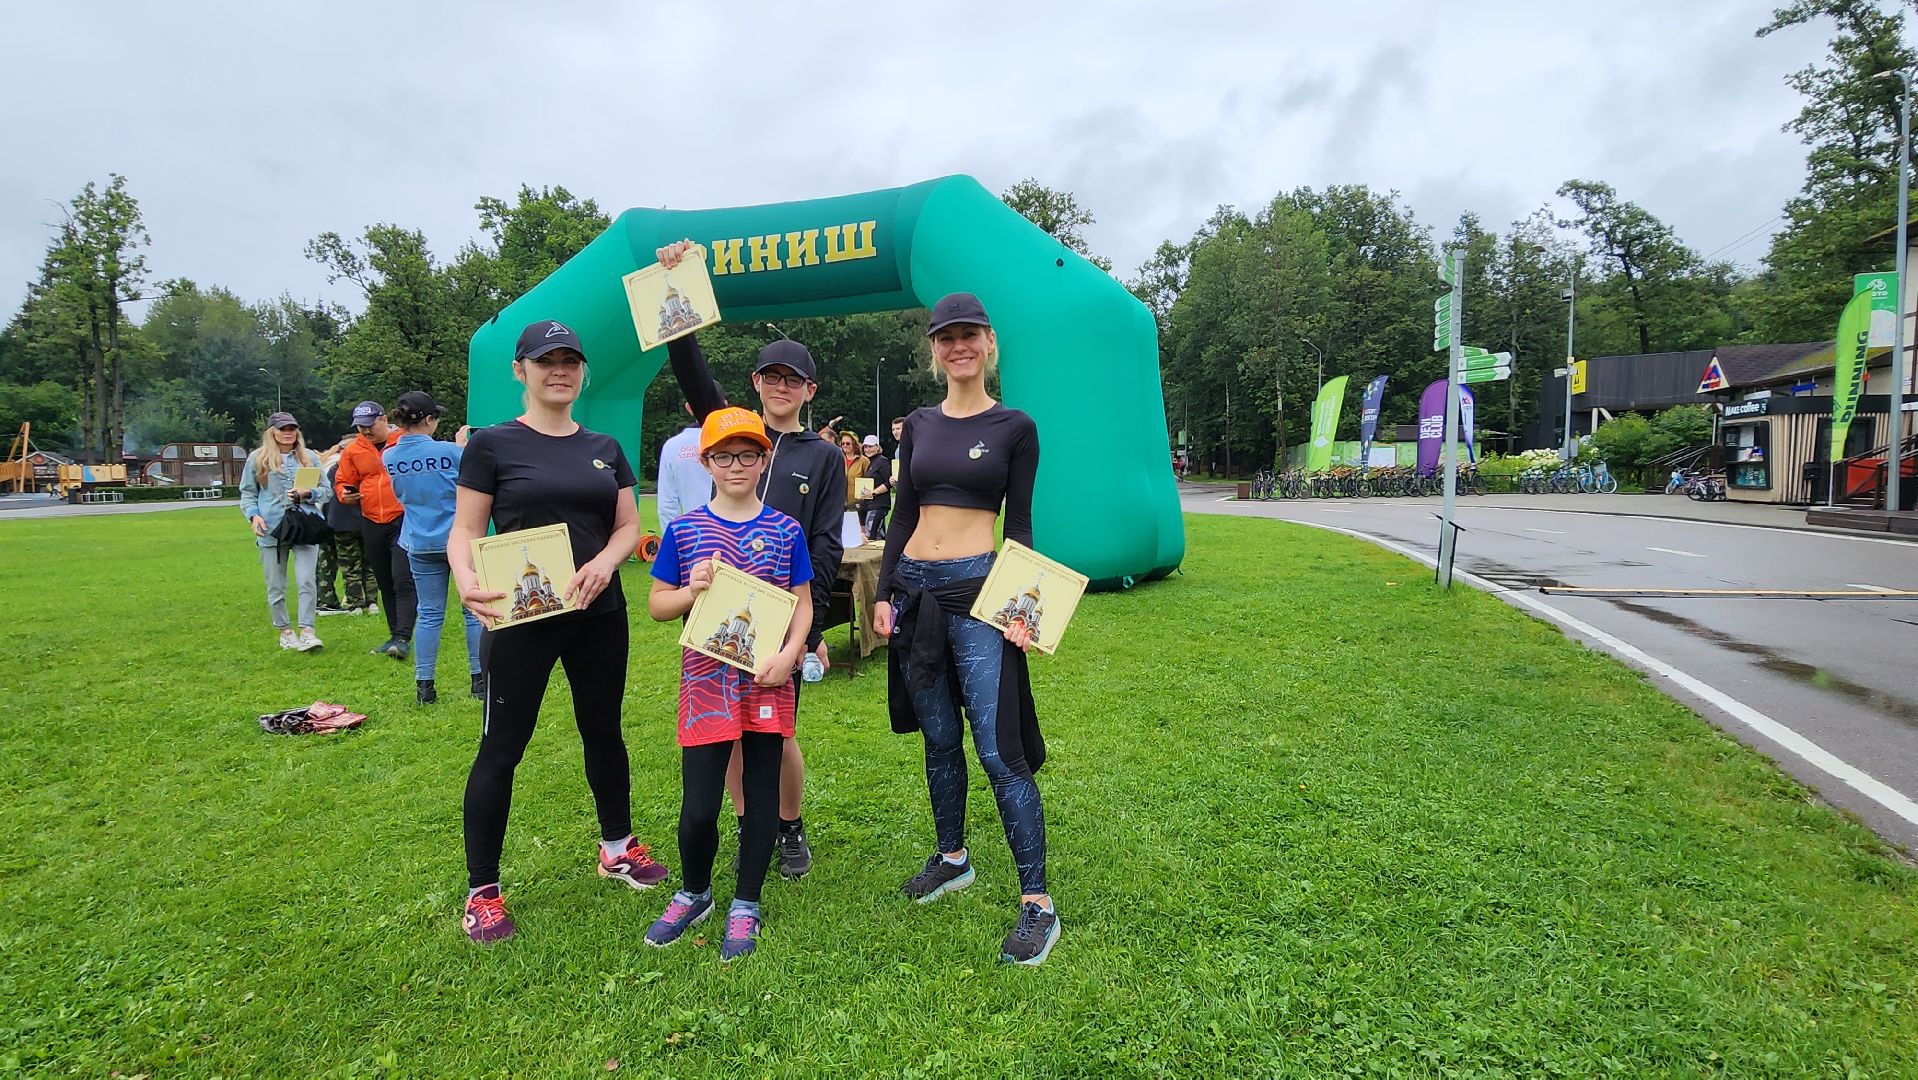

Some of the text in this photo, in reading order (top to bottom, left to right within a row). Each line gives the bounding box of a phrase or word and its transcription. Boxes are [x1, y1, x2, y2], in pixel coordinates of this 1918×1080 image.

[690, 220, 877, 276] ИНИШ
[1740, 402, 1760, 413] coffee
[1420, 418, 1431, 439] DEVI
[1430, 415, 1443, 438] CLUB
[385, 456, 452, 476] ECORD
